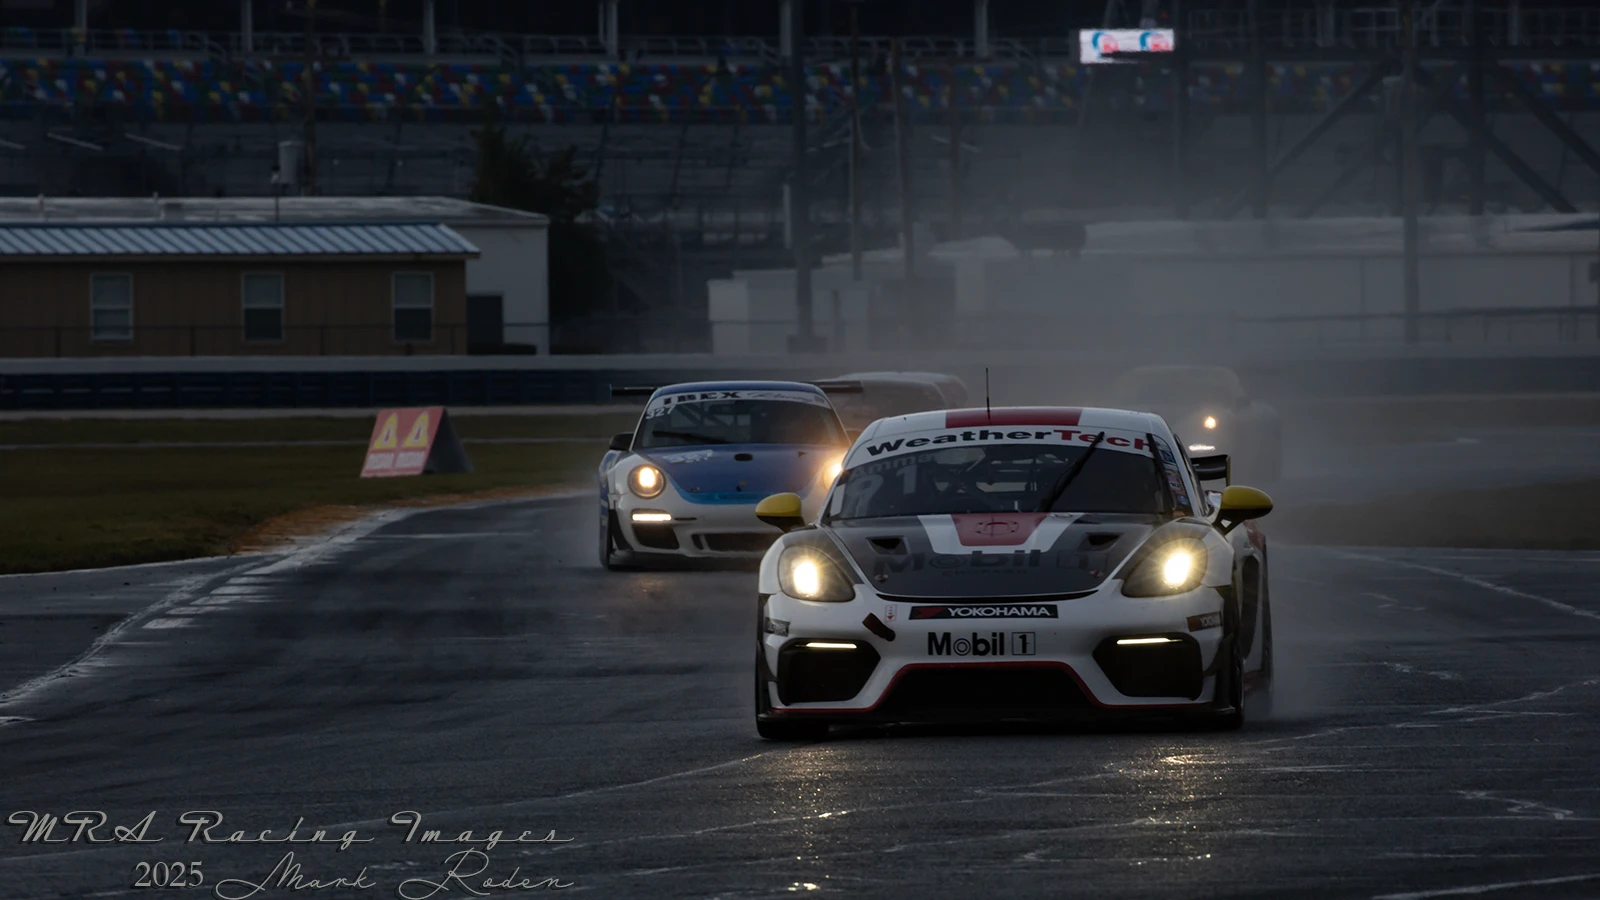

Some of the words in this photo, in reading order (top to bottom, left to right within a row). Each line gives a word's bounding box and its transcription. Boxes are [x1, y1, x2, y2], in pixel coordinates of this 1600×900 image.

[664, 391, 740, 405] IBEX
[645, 405, 677, 420] 327
[866, 429, 1154, 456] WeatherTech
[948, 606, 1052, 618] YOKOHAMA
[928, 632, 1004, 656] Mobil
